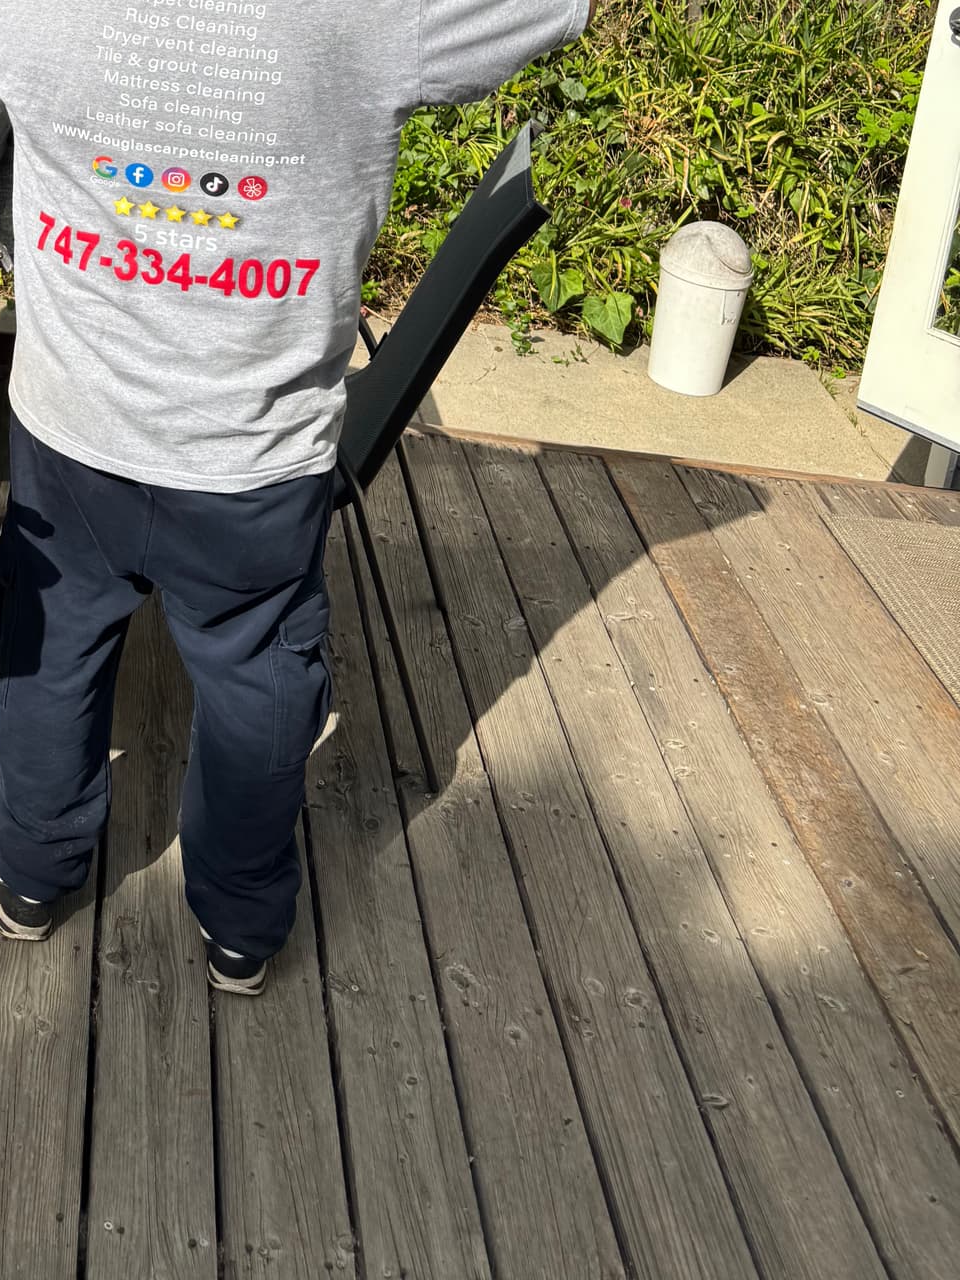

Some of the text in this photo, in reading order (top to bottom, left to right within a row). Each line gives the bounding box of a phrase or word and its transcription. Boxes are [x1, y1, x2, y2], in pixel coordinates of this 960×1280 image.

[125, 7, 258, 40] Rugs Cleaning
[102, 25, 278, 63] Dryer vent cleaning
[95, 45, 282, 85] Tile & grout cleaning
[104, 70, 265, 105] Mattress cleaning
[86, 106, 277, 146] Leather sofa cleaning
[119, 93, 243, 125] Sofa cleaning
[52, 121, 306, 166] www.douglascarpetcleaning.net
[37, 210, 320, 298] 747-334-4007
[134, 224, 218, 252] 5 stars
